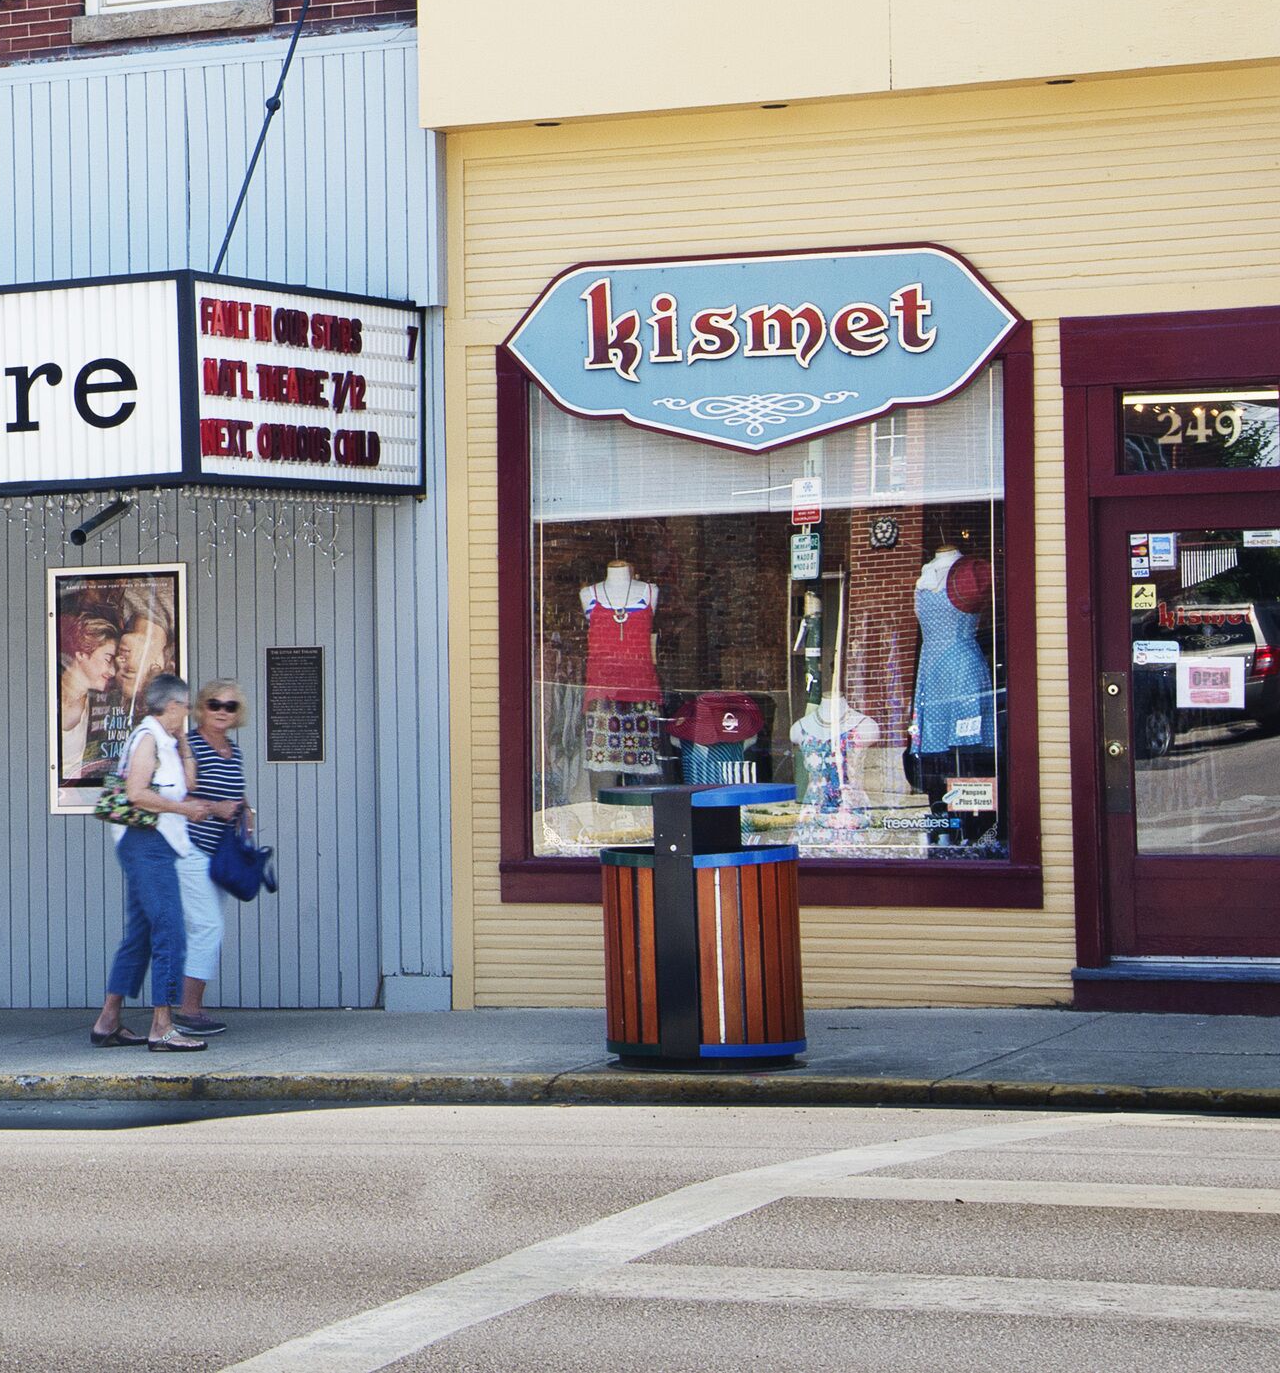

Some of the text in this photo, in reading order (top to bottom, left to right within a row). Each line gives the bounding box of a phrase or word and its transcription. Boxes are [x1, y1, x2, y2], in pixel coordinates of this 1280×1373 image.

[200, 297, 419, 361] FAULT IN OUR STARS 7
[580, 278, 937, 383] kismet
[256, 363, 329, 408] THEATRE
[1157, 408, 1242, 448] 249
[334, 429, 381, 467] CHILD
[1192, 671, 1229, 686] OPEN
[111, 707, 126, 716] THE
[100, 741, 127, 758] STAR
[882, 817, 949, 829] freewaters
